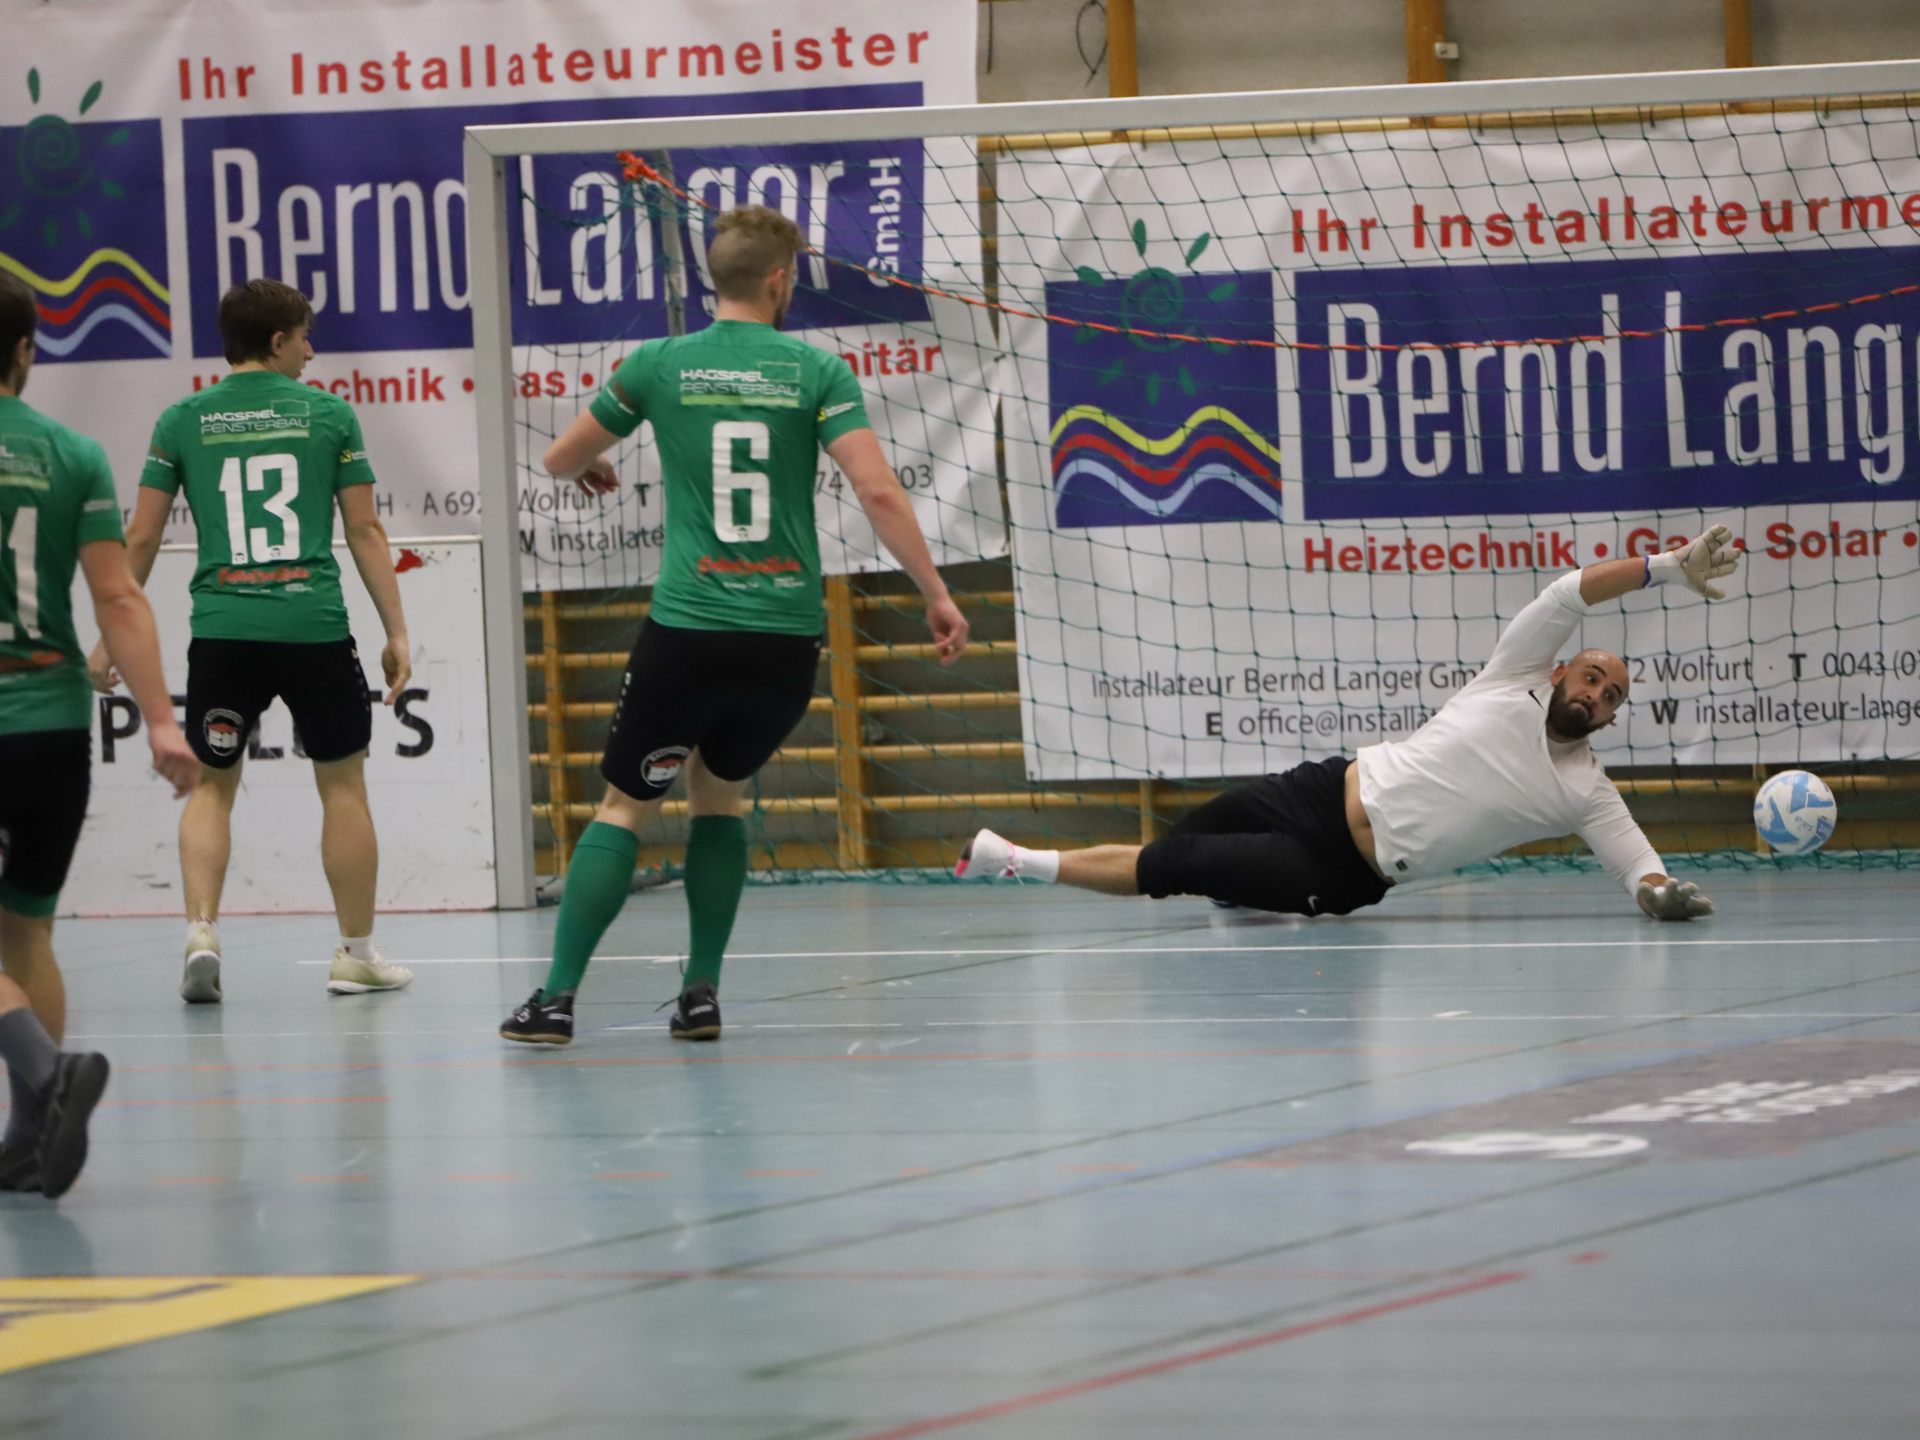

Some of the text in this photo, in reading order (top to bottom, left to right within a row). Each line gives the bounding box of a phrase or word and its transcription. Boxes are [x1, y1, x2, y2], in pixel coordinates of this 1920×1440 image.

[178, 27, 930, 101] Ihr Installateurmeister
[1292, 208, 1377, 253] Ihr
[680, 368, 769, 382] HAGSPIEL
[680, 381, 800, 396] FENSTERBAU
[1327, 290, 1920, 485] Bernd Lang
[201, 409, 281, 423] HAGSPIEL
[201, 419, 310, 435] FENSTERBAU
[424, 493, 438, 515] A
[634, 483, 649, 507] T
[711, 421, 770, 542] 6
[219, 454, 299, 565] 13
[1304, 532, 1576, 574] Heiztechnik
[1766, 520, 1887, 560] Solar
[1092, 671, 1234, 698] Installateur
[1245, 666, 1324, 692] Bernd
[1336, 661, 1420, 696] Langer
[1653, 656, 1753, 683] Wolfurt
[1788, 653, 1806, 678] T
[1206, 712, 1222, 736] E
[1651, 700, 1679, 724] W
